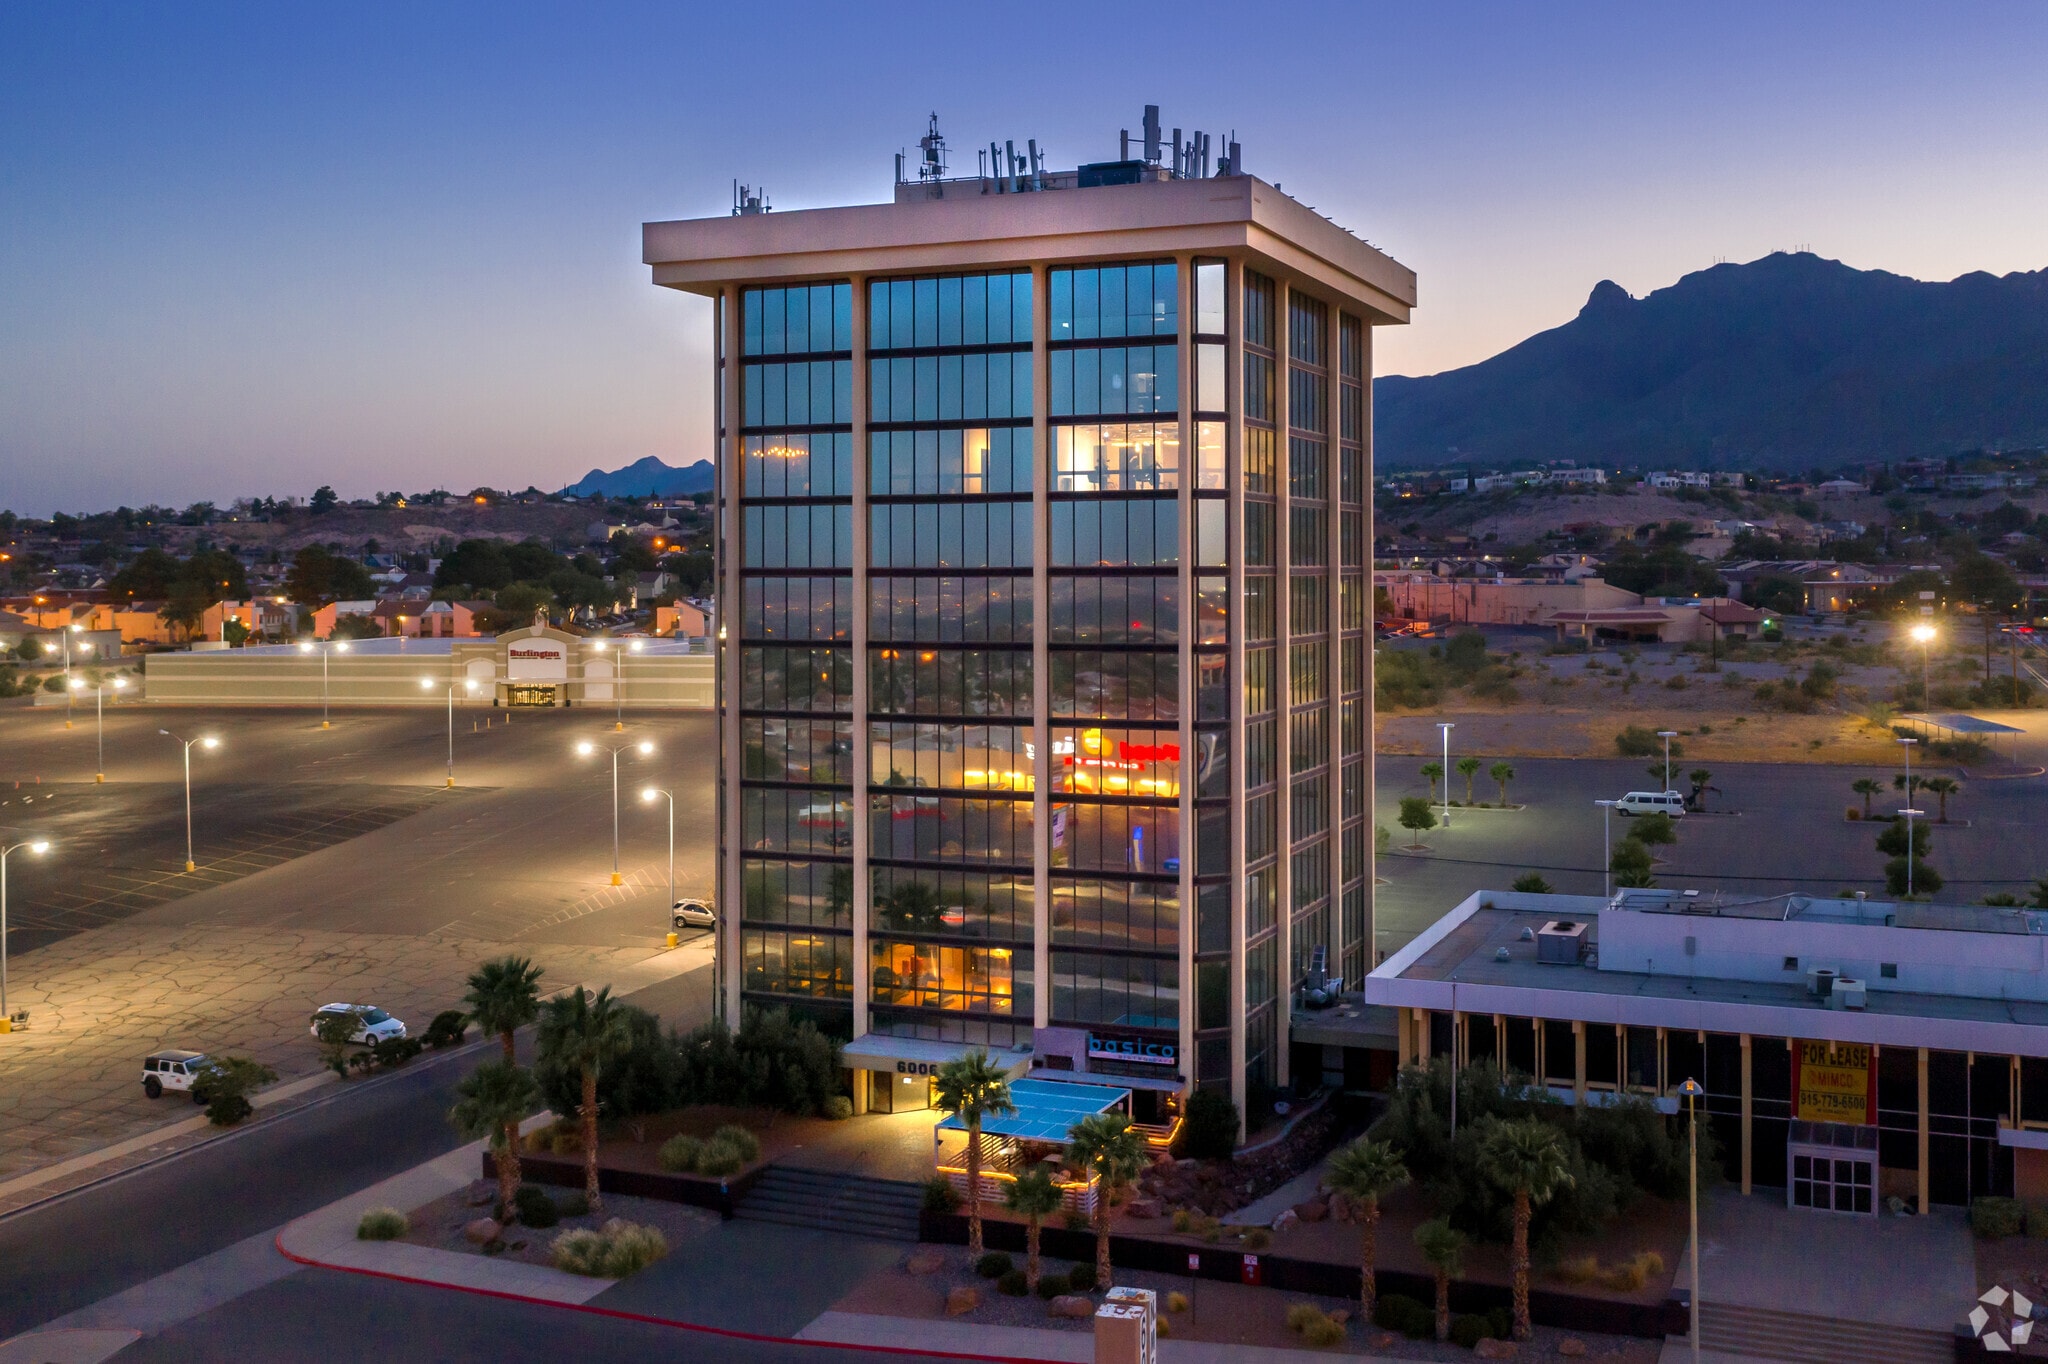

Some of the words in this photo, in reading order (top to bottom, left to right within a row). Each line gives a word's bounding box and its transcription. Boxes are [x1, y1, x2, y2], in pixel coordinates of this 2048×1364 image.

[510, 649, 560, 659] Burlington
[1090, 1033, 1175, 1057] basico
[1802, 1044, 1826, 1064] FOR
[1830, 1046, 1867, 1068] LEASE
[1819, 1072, 1853, 1088] MIMCO
[1801, 1092, 1865, 1110] 915-779-6500
